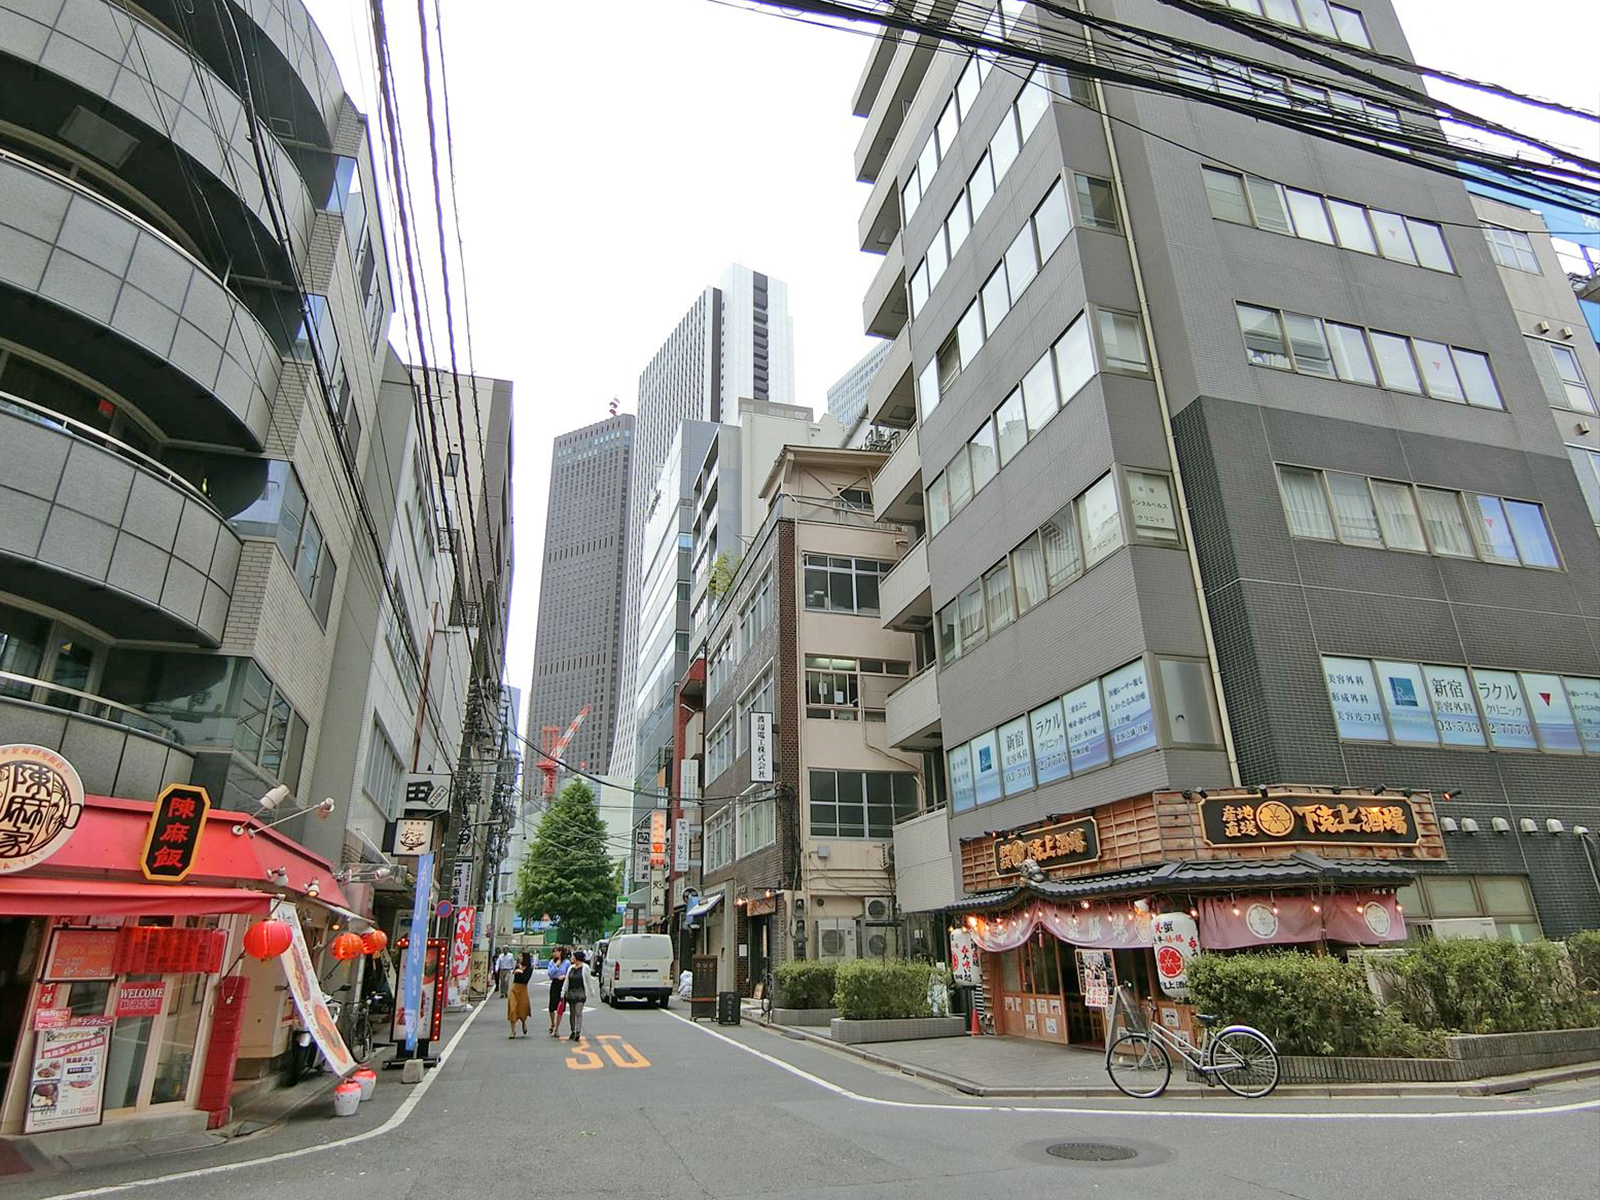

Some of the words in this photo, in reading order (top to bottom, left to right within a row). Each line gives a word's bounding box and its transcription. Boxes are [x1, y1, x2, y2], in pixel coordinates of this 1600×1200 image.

[1328, 674, 1364, 686] 美容外科
[1432, 678, 1464, 698] 新宿
[1478, 682, 1518, 700] ラクル
[1435, 701, 1473, 714] 美容外科
[1486, 704, 1522, 716] クリニック
[1006, 730, 1024, 752] 新宿
[1036, 713, 1061, 738] ラクル
[1222, 805, 1254, 822] 産地
[153, 797, 197, 868] 陳麻飯
[1225, 821, 1259, 837] 直送
[120, 988, 164, 999] WELCOME
[558, 1034, 653, 1071] 30
